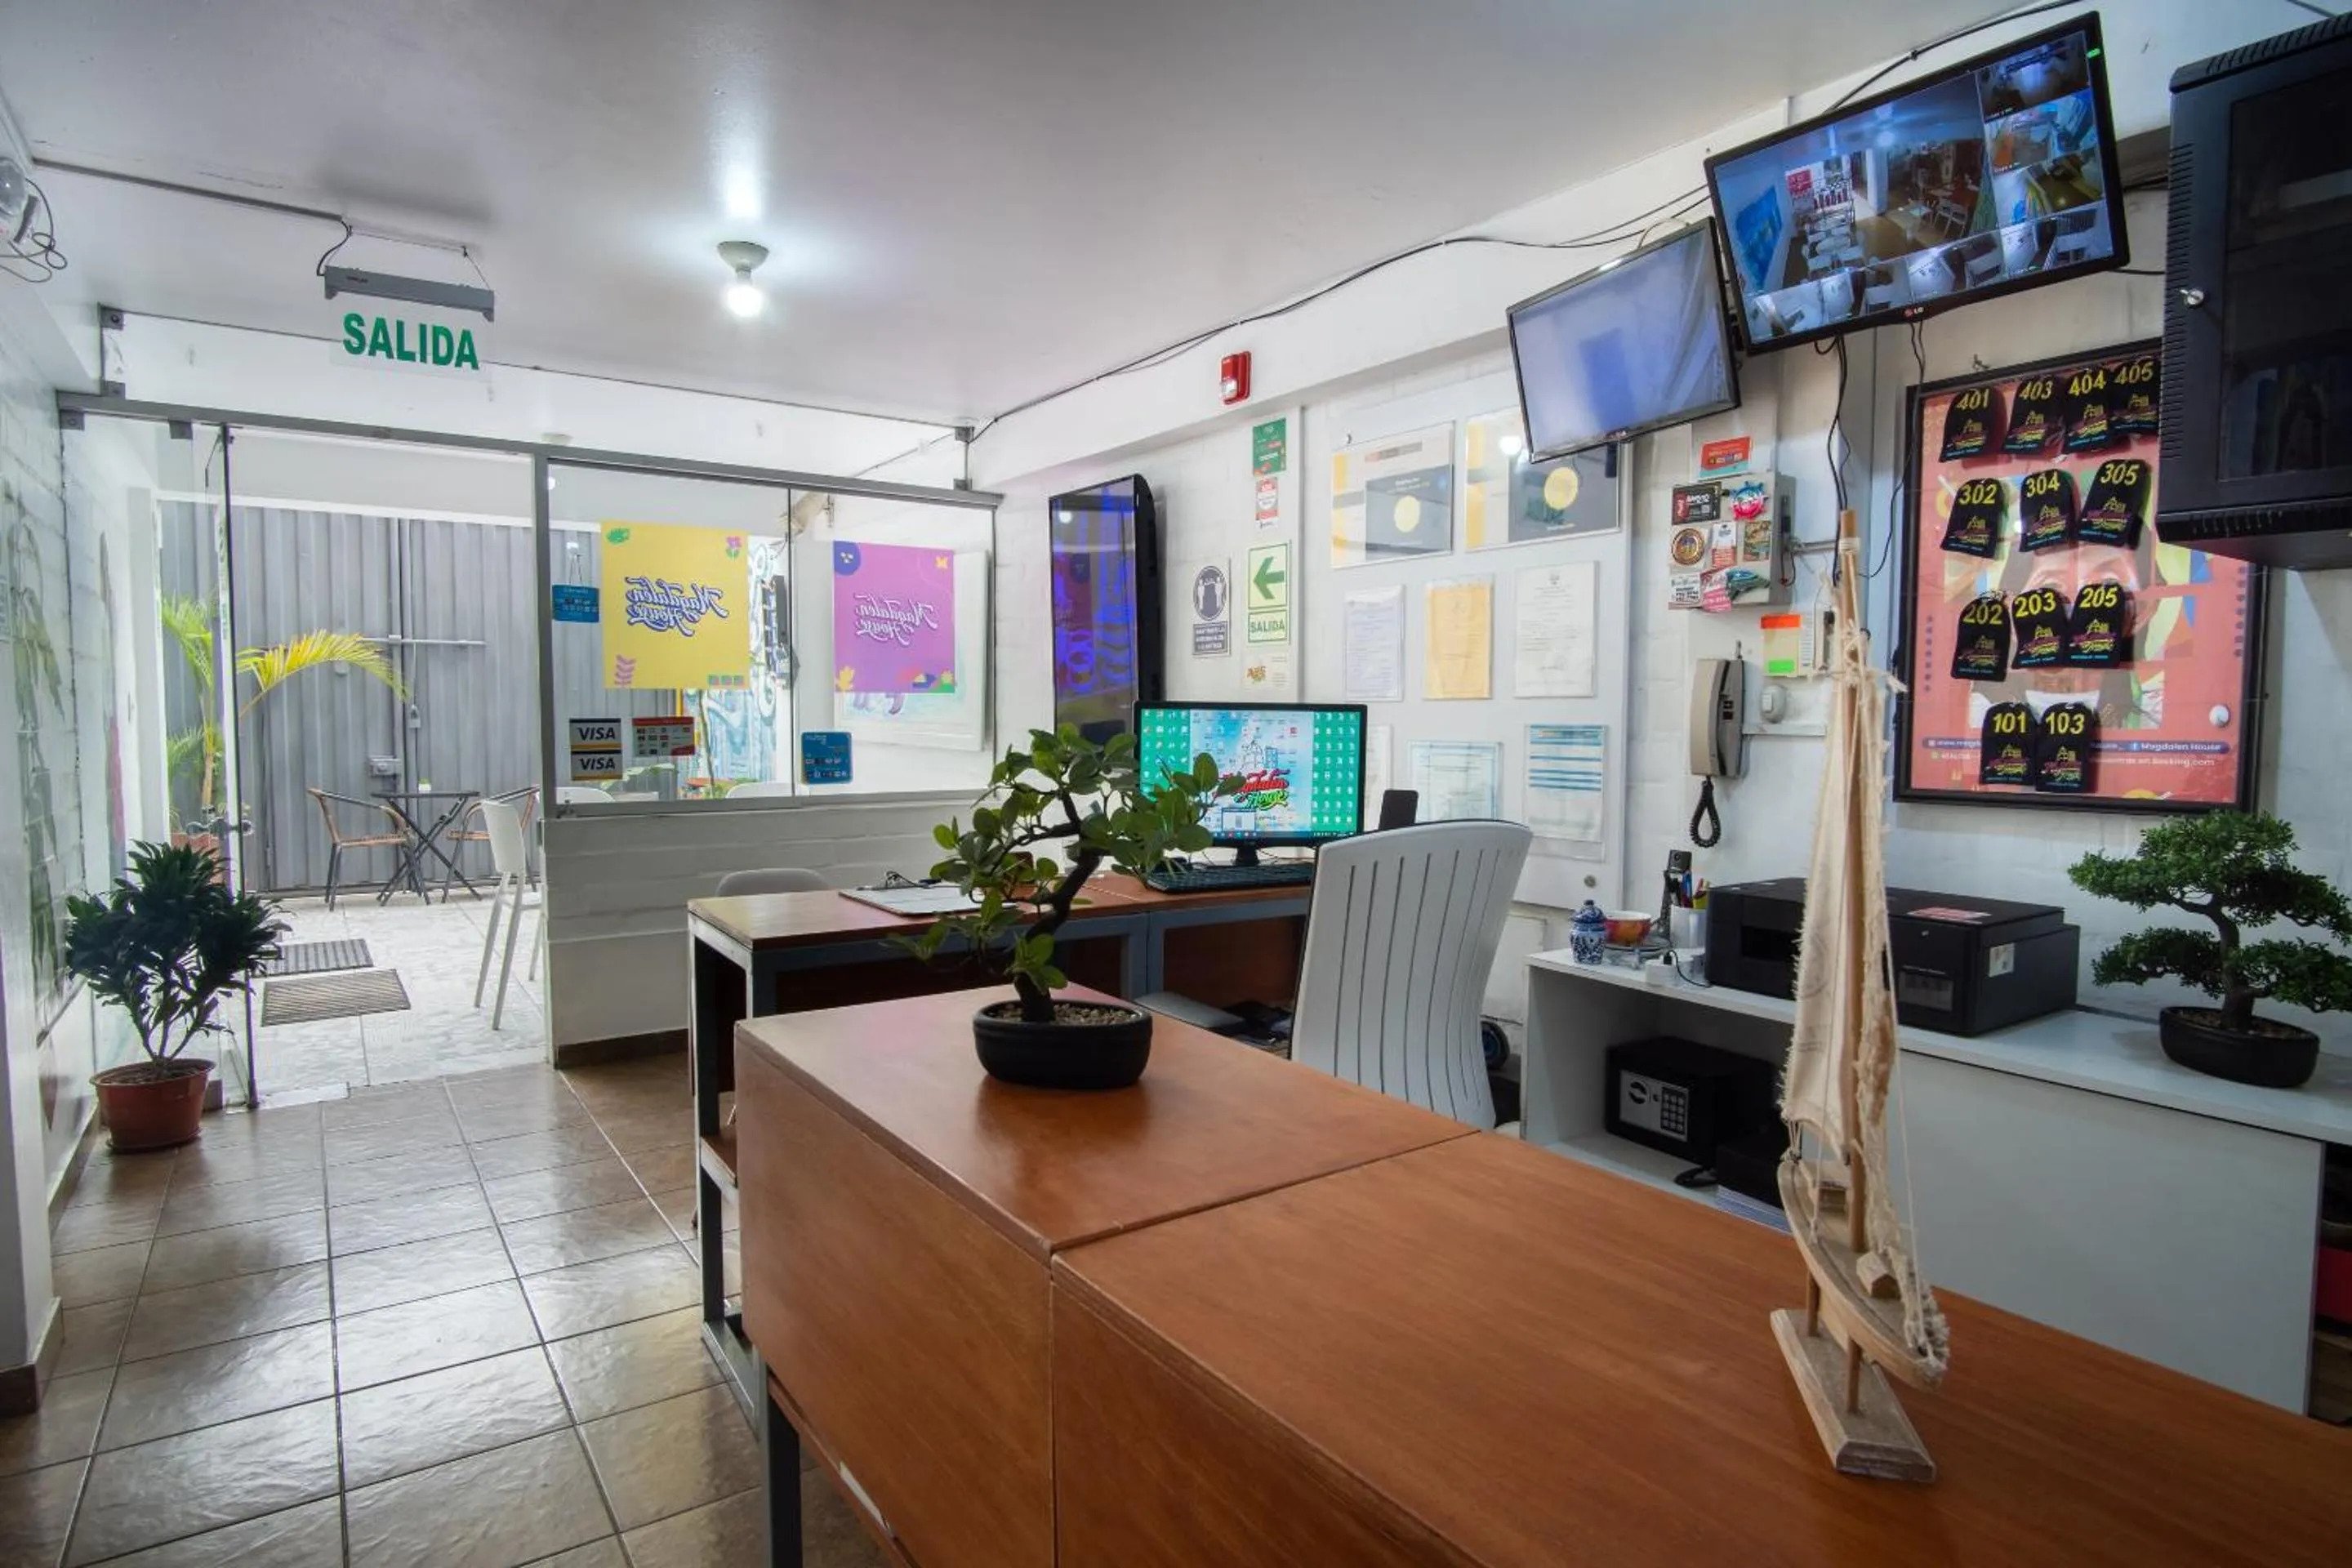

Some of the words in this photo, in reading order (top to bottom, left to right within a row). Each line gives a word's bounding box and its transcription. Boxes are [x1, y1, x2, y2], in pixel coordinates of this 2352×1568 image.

[343, 313, 479, 371] SALIDA
[2069, 369, 2107, 396] 404
[2114, 362, 2154, 385] 405
[1956, 388, 1990, 411] 401
[2019, 381, 2053, 400] 403
[2025, 471, 2060, 498] 304
[2100, 463, 2140, 486] 305
[1958, 483, 1998, 505] 302
[2015, 592, 2056, 617] 203
[2079, 586, 2118, 608] 205
[1962, 604, 2002, 625] 202
[1250, 618, 1285, 634] SALIDA
[1993, 712, 2026, 733] 101
[2046, 712, 2085, 734] 103
[577, 727, 615, 741] VISA
[580, 758, 616, 770] VISA
